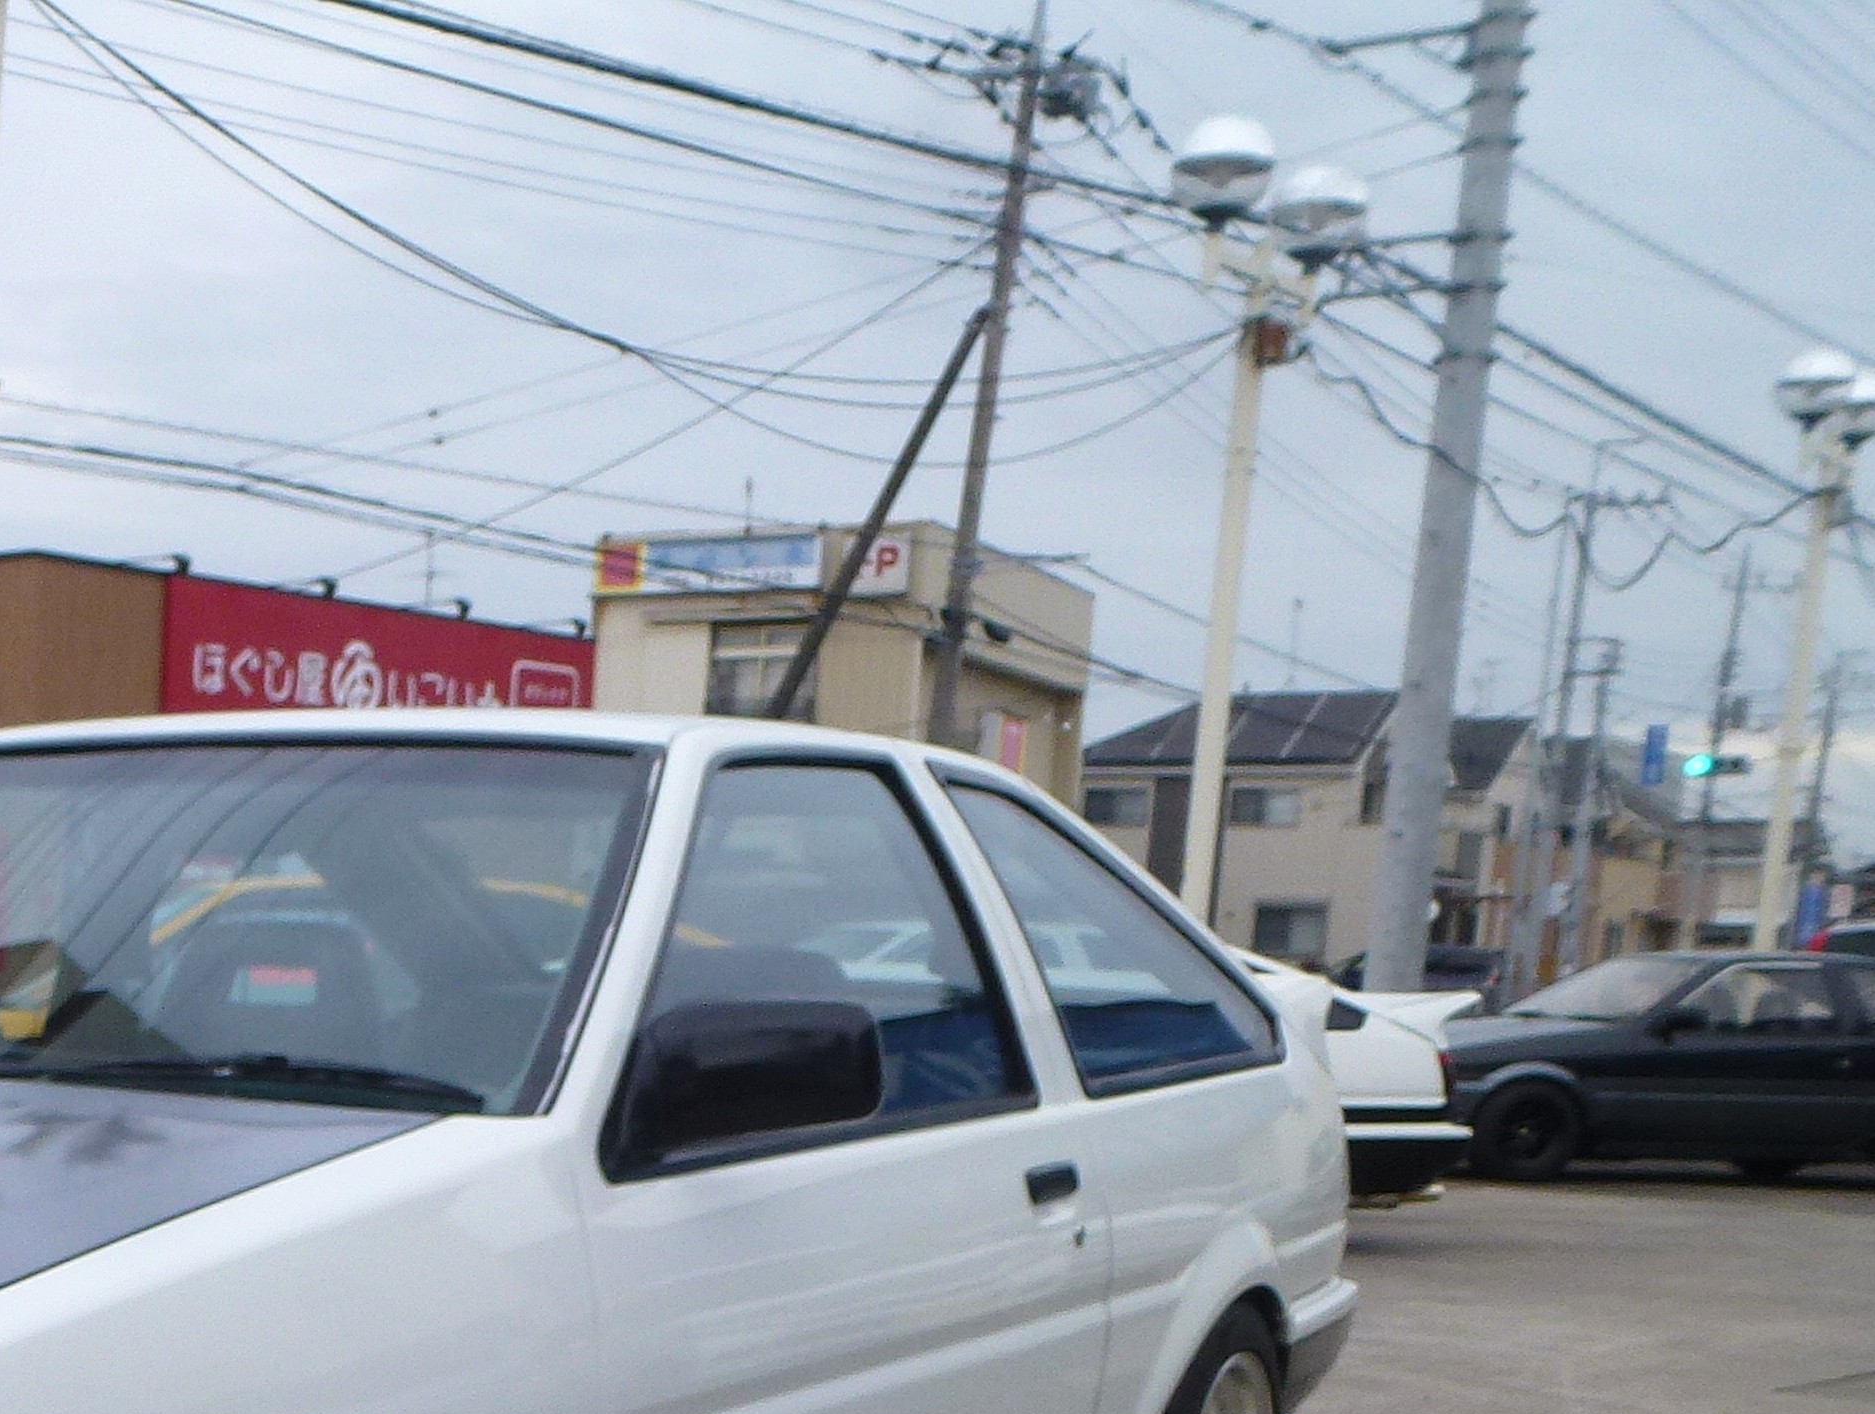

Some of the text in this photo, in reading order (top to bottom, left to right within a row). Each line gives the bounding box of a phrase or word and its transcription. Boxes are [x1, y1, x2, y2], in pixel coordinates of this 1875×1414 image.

[877, 546, 899, 578] P
[192, 643, 329, 706] ほぐし屋
